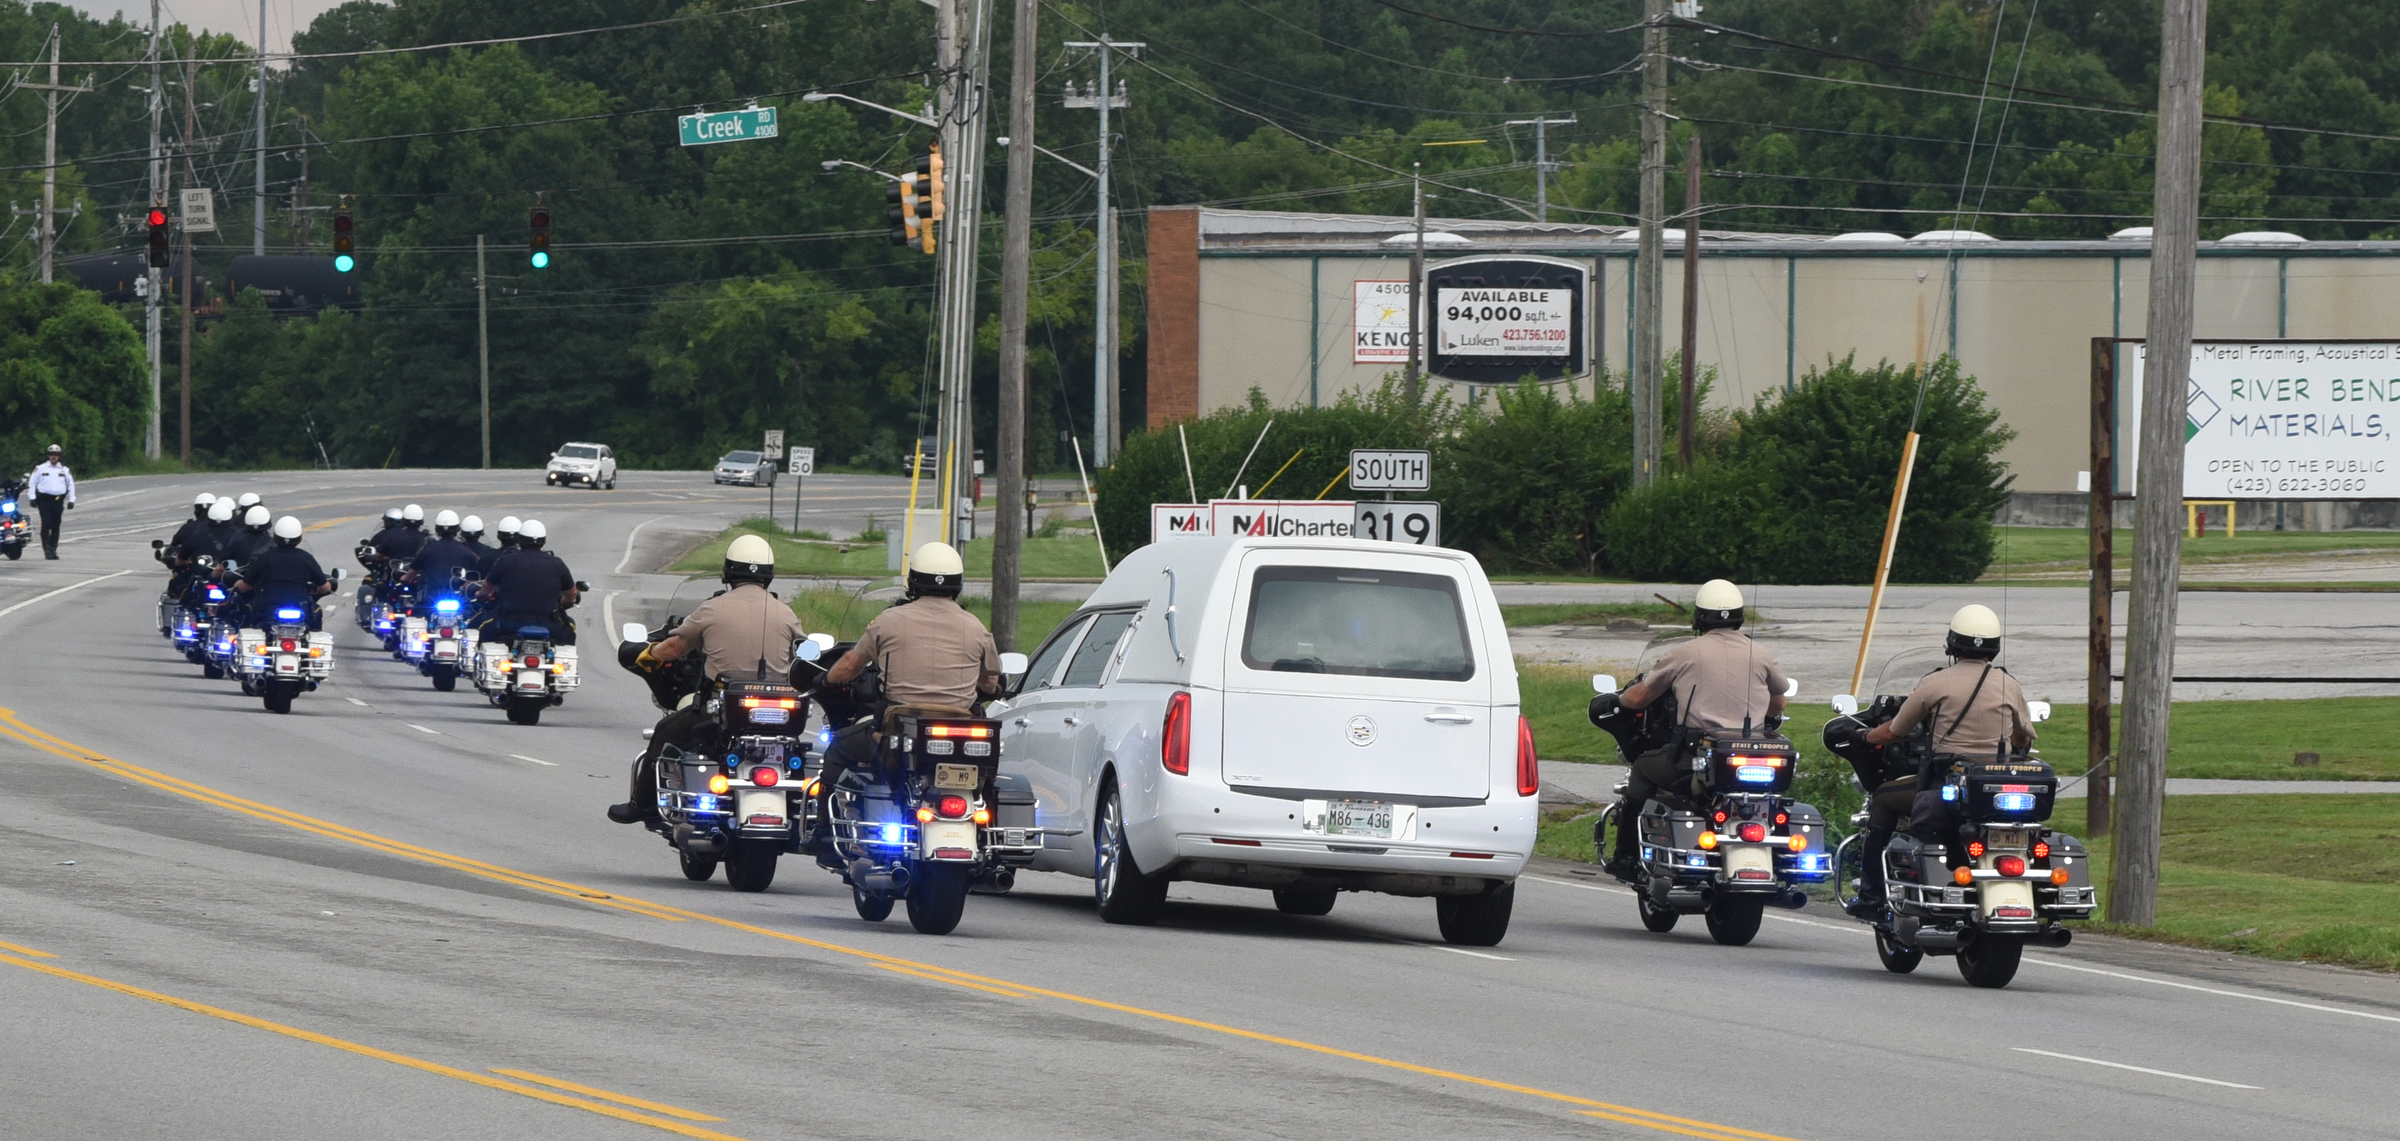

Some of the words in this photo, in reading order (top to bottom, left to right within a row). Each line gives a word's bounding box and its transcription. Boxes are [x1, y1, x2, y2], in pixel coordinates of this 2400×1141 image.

[682, 118, 688, 129] S
[696, 115, 744, 139] Creek
[758, 111, 770, 123] RD
[754, 123, 776, 136] 4100
[187, 193, 205, 201] LEFT
[188, 204, 206, 213] TURN
[186, 216, 211, 226] SIGNAL
[1375, 284, 1410, 294] 4500
[1461, 291, 1549, 302] AVAILABLE
[1447, 306, 1522, 324] 94,000
[1461, 334, 1499, 346] Luken
[1502, 329, 1566, 341] 423.756.1200
[2204, 346, 2244, 360] Metal
[2250, 345, 2310, 363] Framing,
[2314, 345, 2389, 360] Acoustical
[2230, 377, 2310, 402] RIVER
[2331, 377, 2400, 402] BEND
[2229, 413, 2391, 441] MATERIALS,
[791, 461, 810, 473] 50
[1356, 458, 1424, 481] SOUTH
[2207, 459, 2254, 473] OPEN
[2260, 459, 2282, 473] TO
[2288, 460, 2319, 473] THE
[2325, 459, 2386, 473] PUBLIC
[2226, 477, 2272, 495] (423)
[2278, 477, 2366, 492] 622-3060
[1169, 510, 1200, 532] NAI
[1232, 509, 1272, 537] NAI
[1361, 510, 1431, 545] 319
[2009, 764, 2042, 772] TROOPER
[958, 772, 969, 782] M9
[1329, 809, 1352, 826] M86
[1366, 812, 1390, 829] 43G
[2005, 833, 2019, 844] M11
